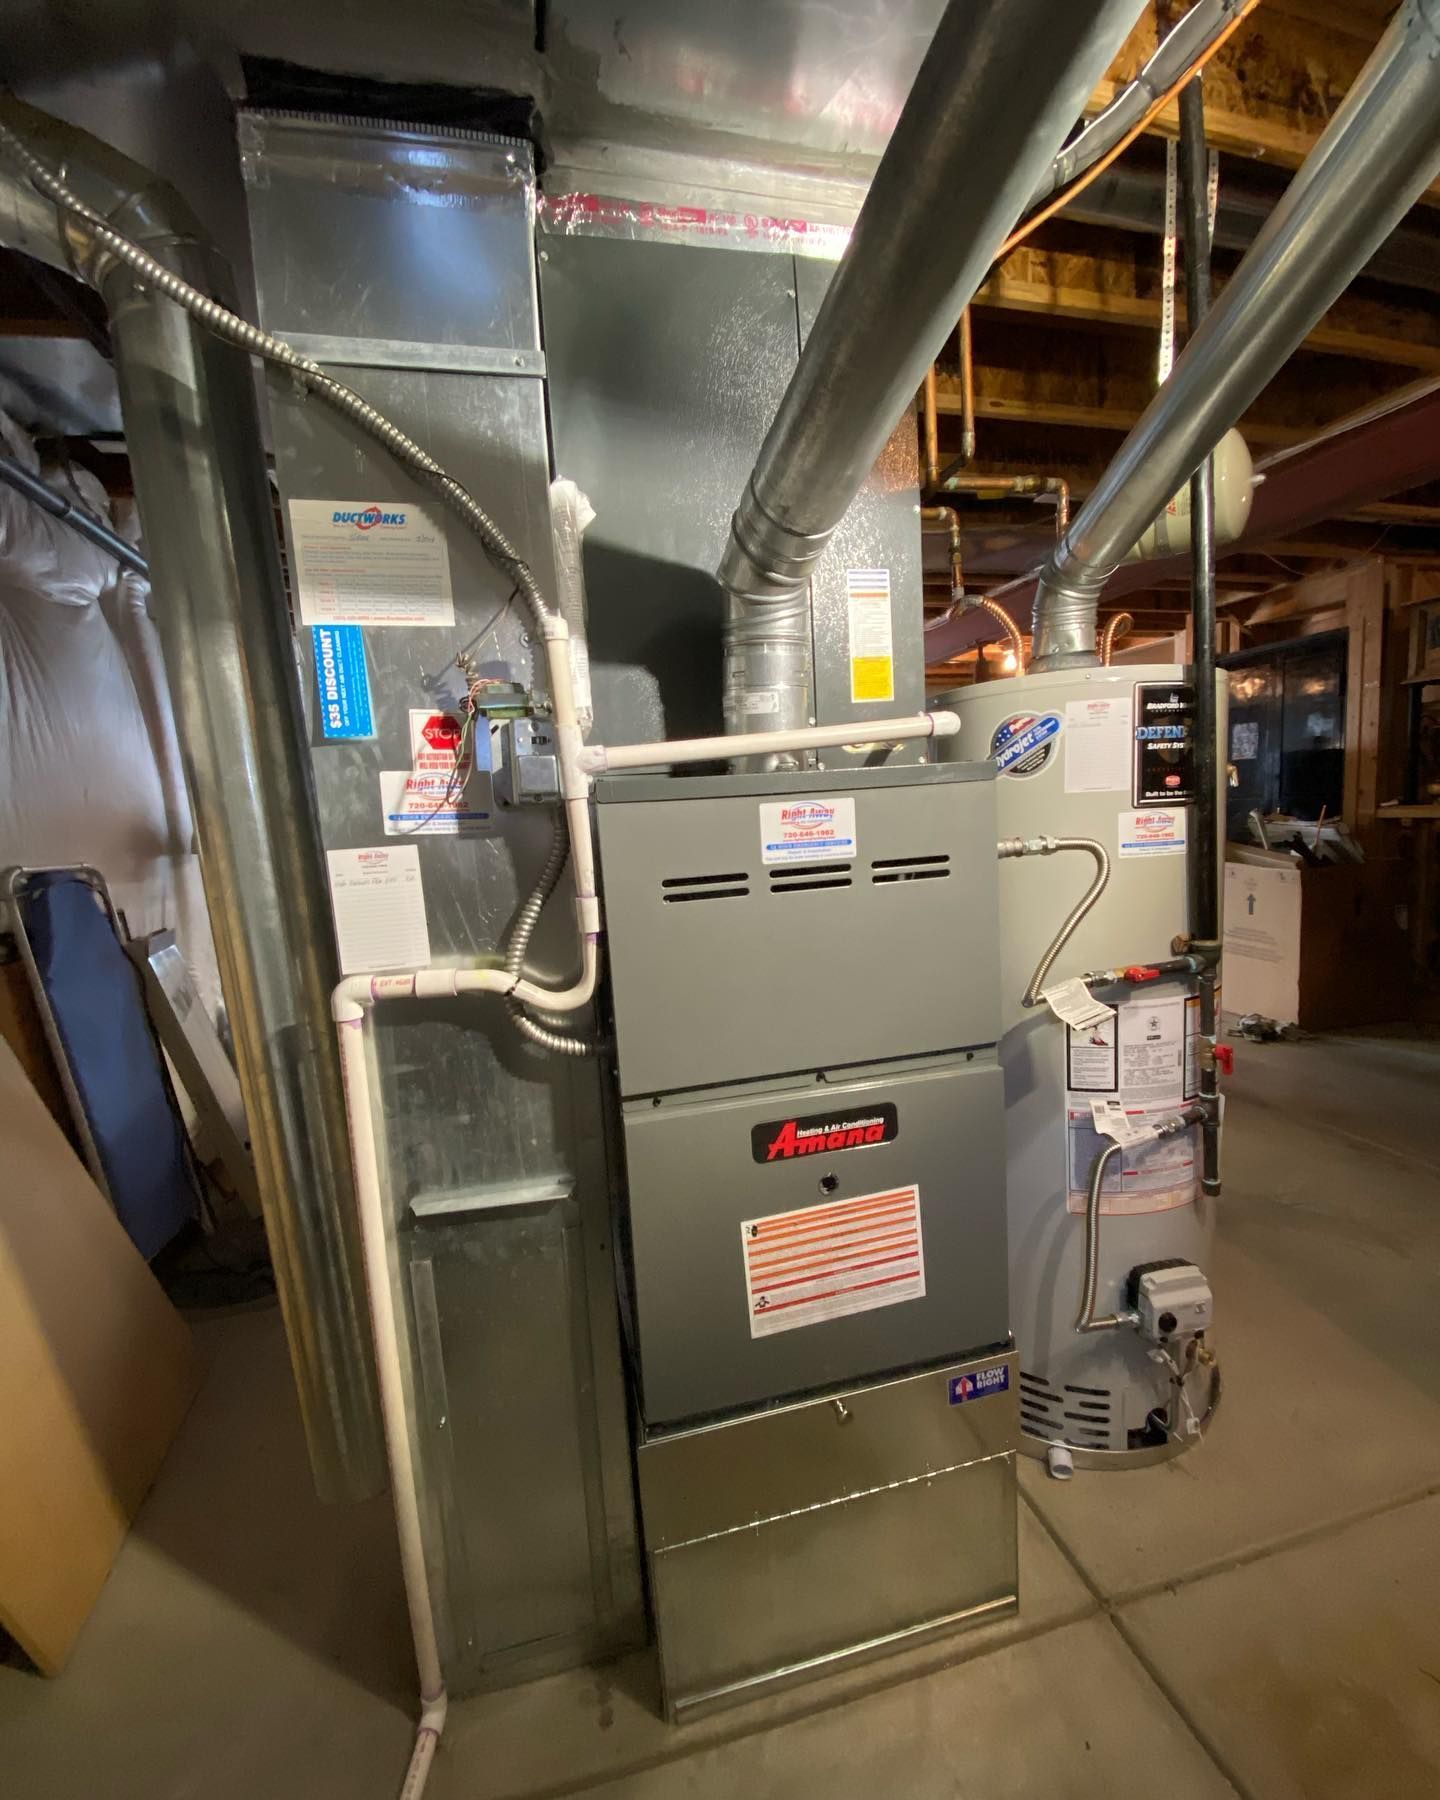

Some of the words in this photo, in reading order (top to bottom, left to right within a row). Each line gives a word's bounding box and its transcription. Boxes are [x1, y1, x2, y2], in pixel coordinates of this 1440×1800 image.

[332, 511, 406, 525] DUCTWORKS
[319, 628, 339, 700] DISCOUNT
[1146, 702, 1180, 710] BRADFORD
[328, 703, 342, 728] $35
[995, 732, 1035, 768] ydrojet
[1146, 742, 1172, 750] SAFETY
[406, 778, 435, 791] Right
[781, 808, 806, 821] Right
[797, 1126, 823, 1139] Heating
[824, 1125, 830, 1133] &
[830, 1123, 841, 1131] Air
[842, 1117, 884, 1129] Conditioning
[767, 1121, 885, 1160] Amana
[976, 1367, 1005, 1380] FLOW
[977, 1375, 1005, 1389] RIGHT
